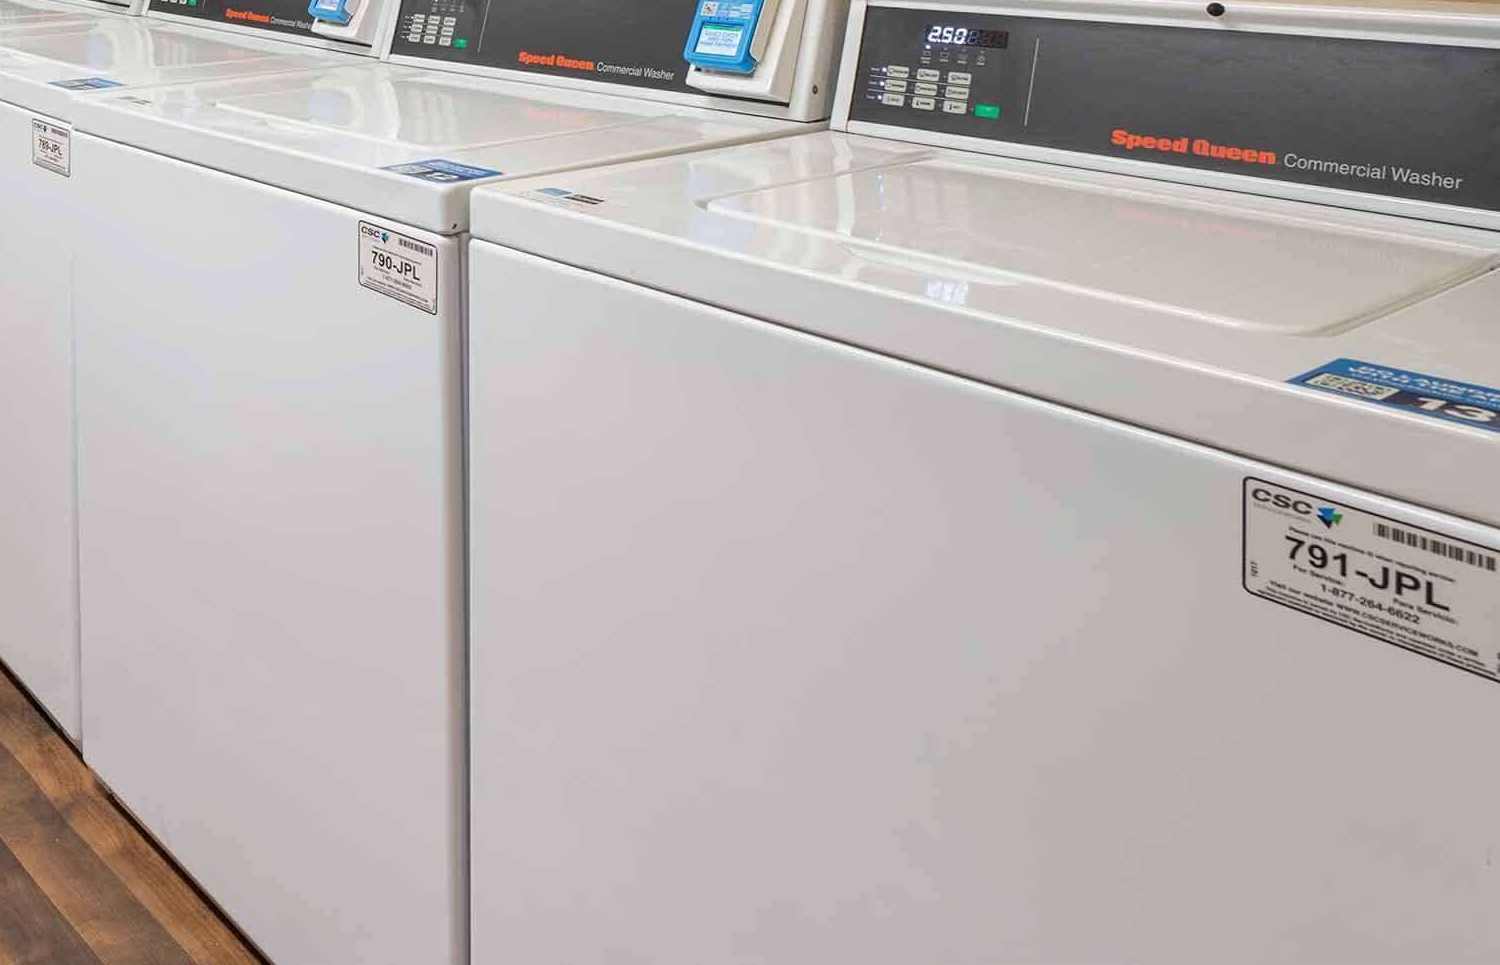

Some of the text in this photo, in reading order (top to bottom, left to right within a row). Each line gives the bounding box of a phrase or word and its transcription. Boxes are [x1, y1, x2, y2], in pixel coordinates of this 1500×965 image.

[518, 51, 675, 81] Speed Queen Commercial Washer
[1110, 128, 1464, 190] Speed Queen Commercial Washer
[361, 226, 380, 238] CSC
[371, 250, 420, 281] 790-JPL
[1252, 488, 1313, 515] CSC
[1285, 535, 1450, 612] 791-JPL
